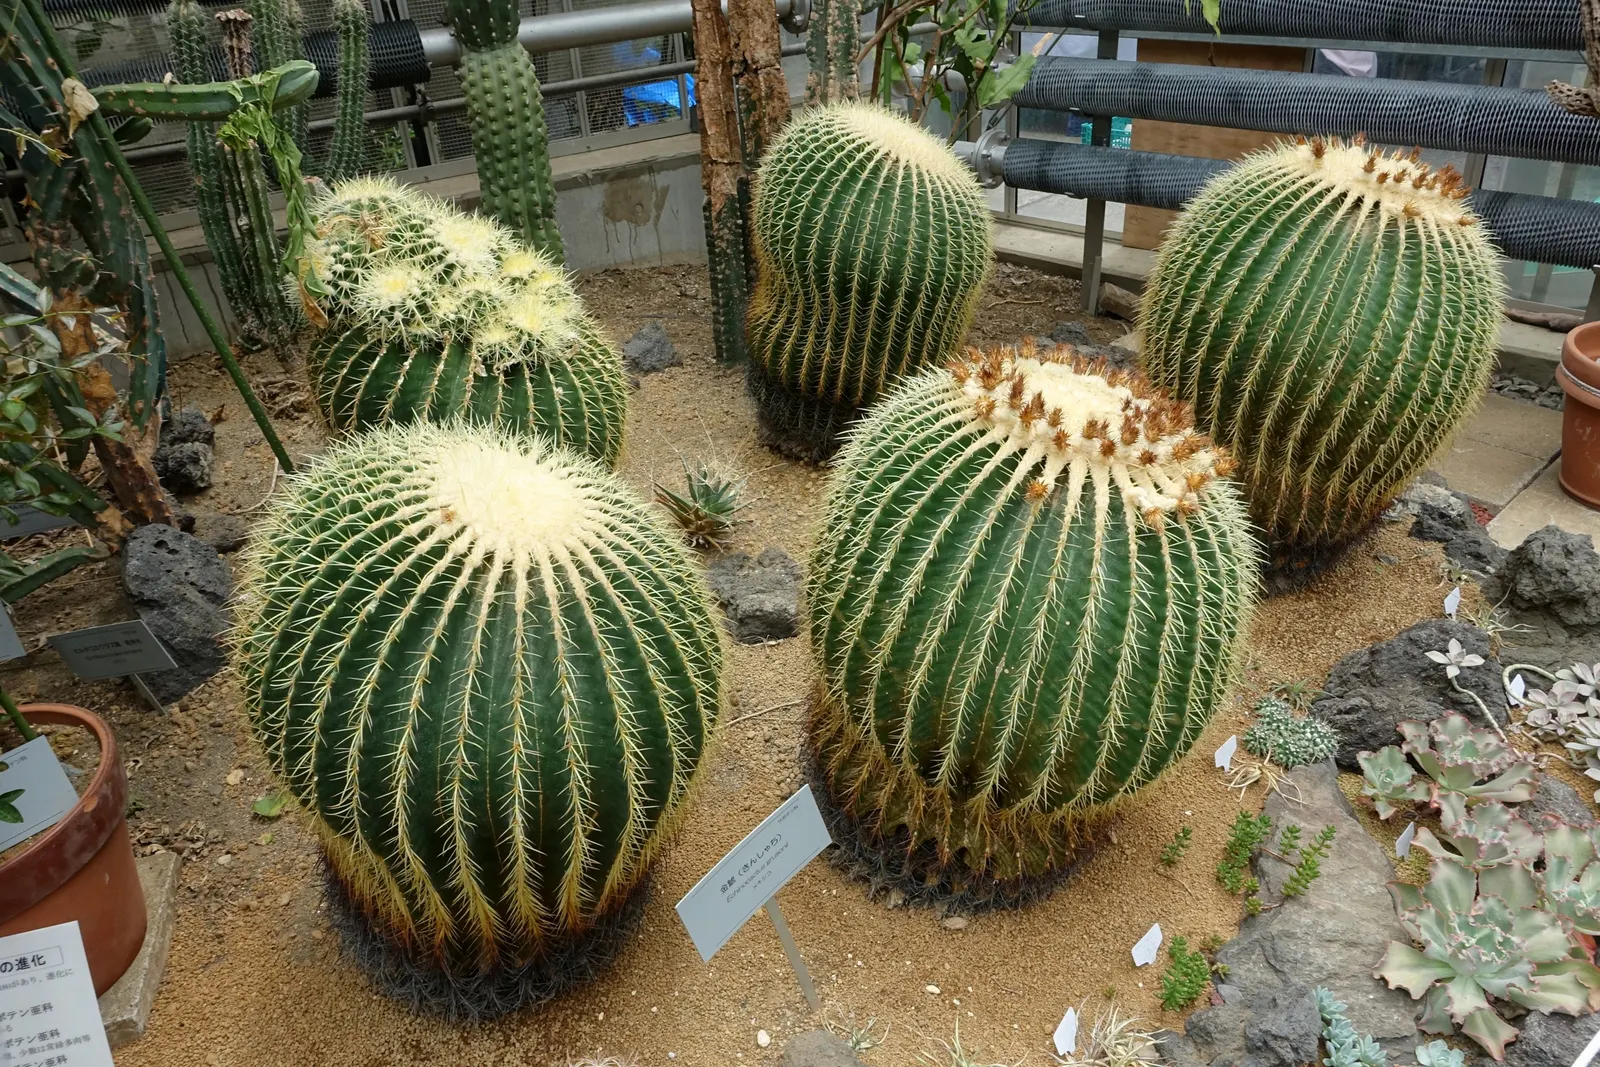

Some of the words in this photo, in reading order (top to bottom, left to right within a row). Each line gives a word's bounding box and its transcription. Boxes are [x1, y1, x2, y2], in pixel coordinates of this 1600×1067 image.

[753, 870, 772, 890] メキシコ
[0, 953, 46, 974] の進化
[0, 1028, 61, 1049] ボテン亜科
